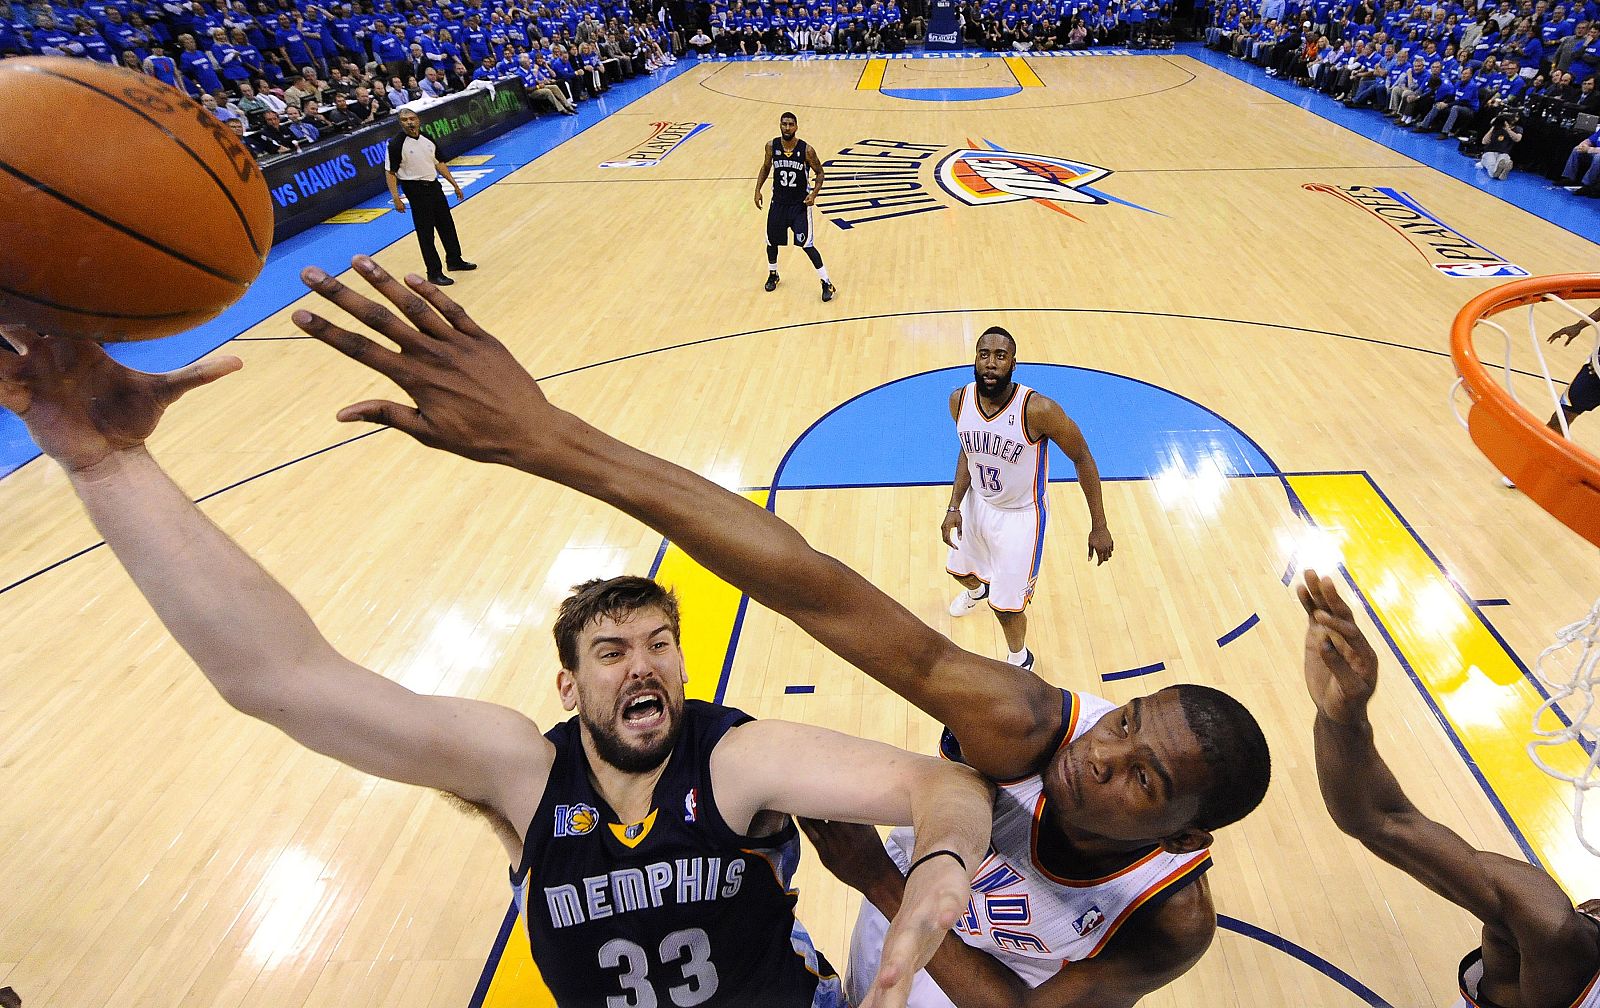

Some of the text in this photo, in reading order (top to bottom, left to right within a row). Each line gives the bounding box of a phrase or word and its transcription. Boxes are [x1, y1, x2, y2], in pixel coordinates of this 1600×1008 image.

[432, 117, 452, 138] PM
[626, 121, 698, 160] PLAYOFFS
[294, 154, 357, 199] HAWKS
[774, 159, 804, 171] MEMPHIS
[779, 170, 797, 188] 32
[810, 139, 949, 231] THUNDER
[1336, 185, 1499, 262] PLAYOFFS
[959, 430, 1025, 464] THUNDER
[975, 463, 1003, 492] 13
[544, 856, 746, 929] MEMPHIS
[598, 928, 719, 1008] 33
